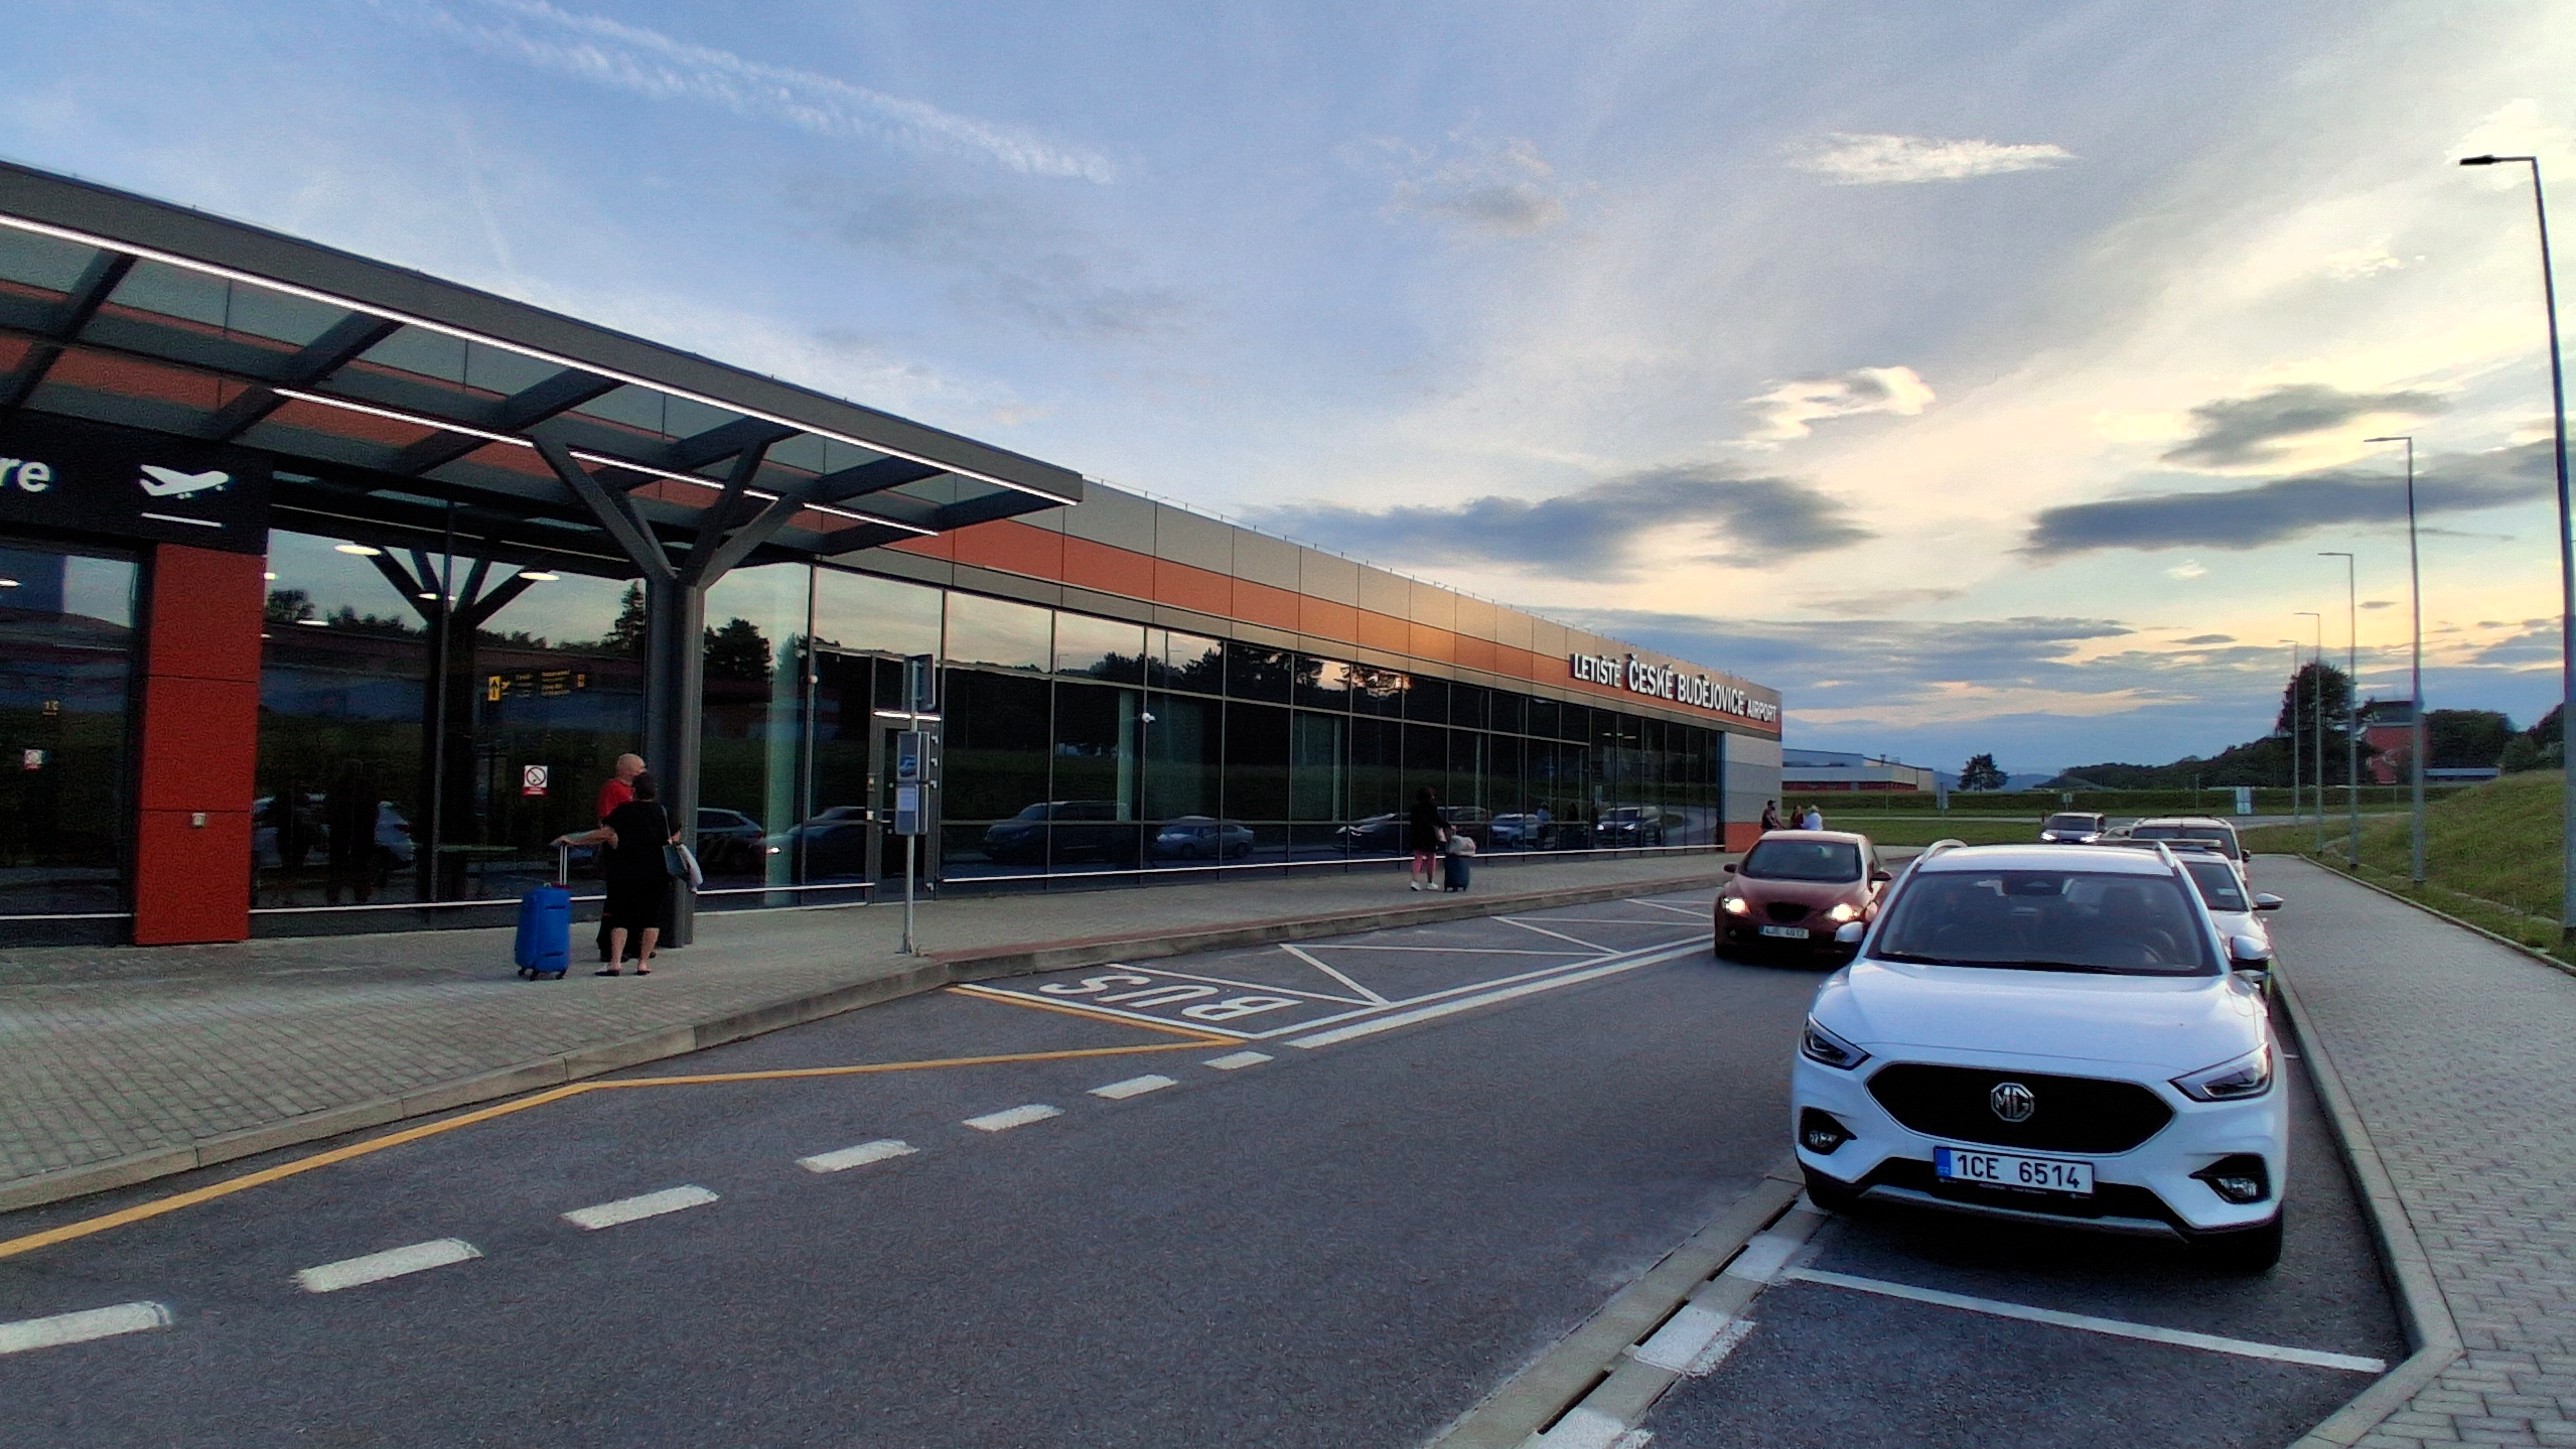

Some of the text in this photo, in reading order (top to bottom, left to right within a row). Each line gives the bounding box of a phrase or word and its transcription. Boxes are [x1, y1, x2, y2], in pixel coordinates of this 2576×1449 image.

[1573, 652, 1778, 723] LETIŠTĚ ČESKÉ BUDĚJOVICE AIRPORT
[1039, 975, 1303, 1021] BUS
[1994, 1086, 2031, 1118] MG
[1957, 1154, 1999, 1180] 1CE
[2019, 1161, 2080, 1188] 6514
